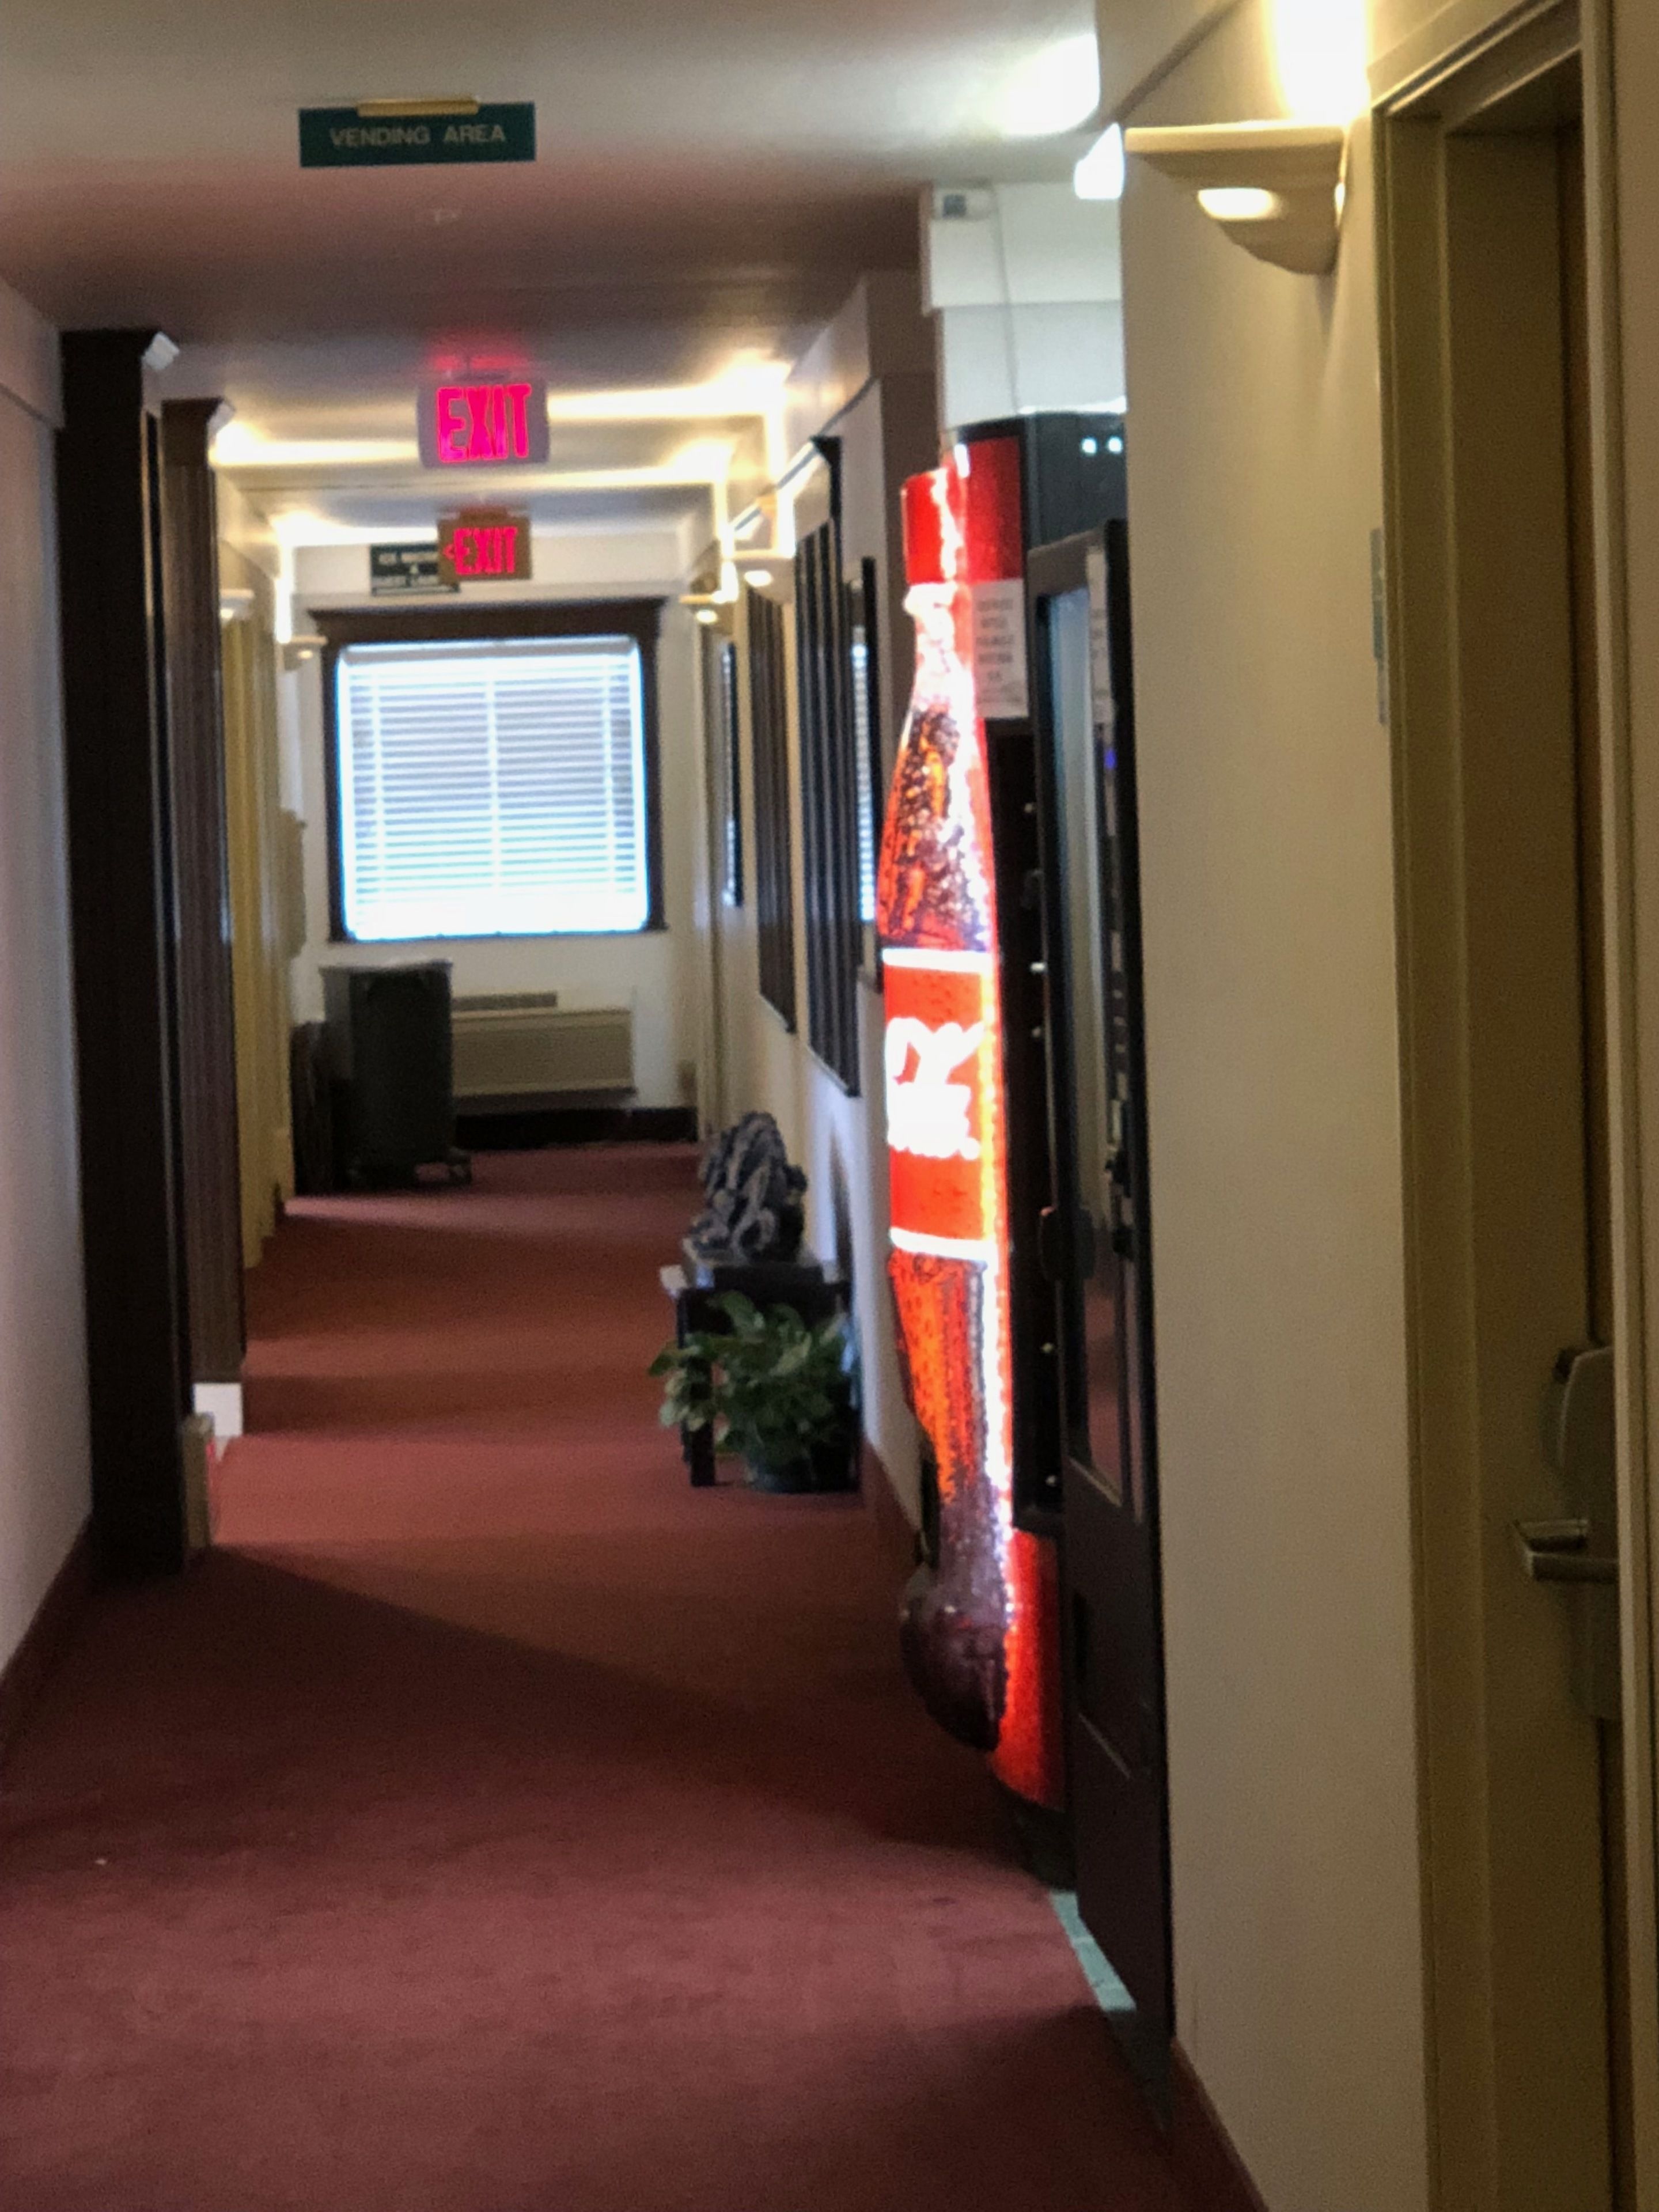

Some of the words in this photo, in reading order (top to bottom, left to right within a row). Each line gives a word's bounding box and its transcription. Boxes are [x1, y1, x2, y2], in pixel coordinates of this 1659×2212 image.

[329, 125, 431, 146] VENDING
[443, 124, 506, 143] AREA
[437, 384, 532, 464] EXIT
[453, 527, 518, 575] EXIT
